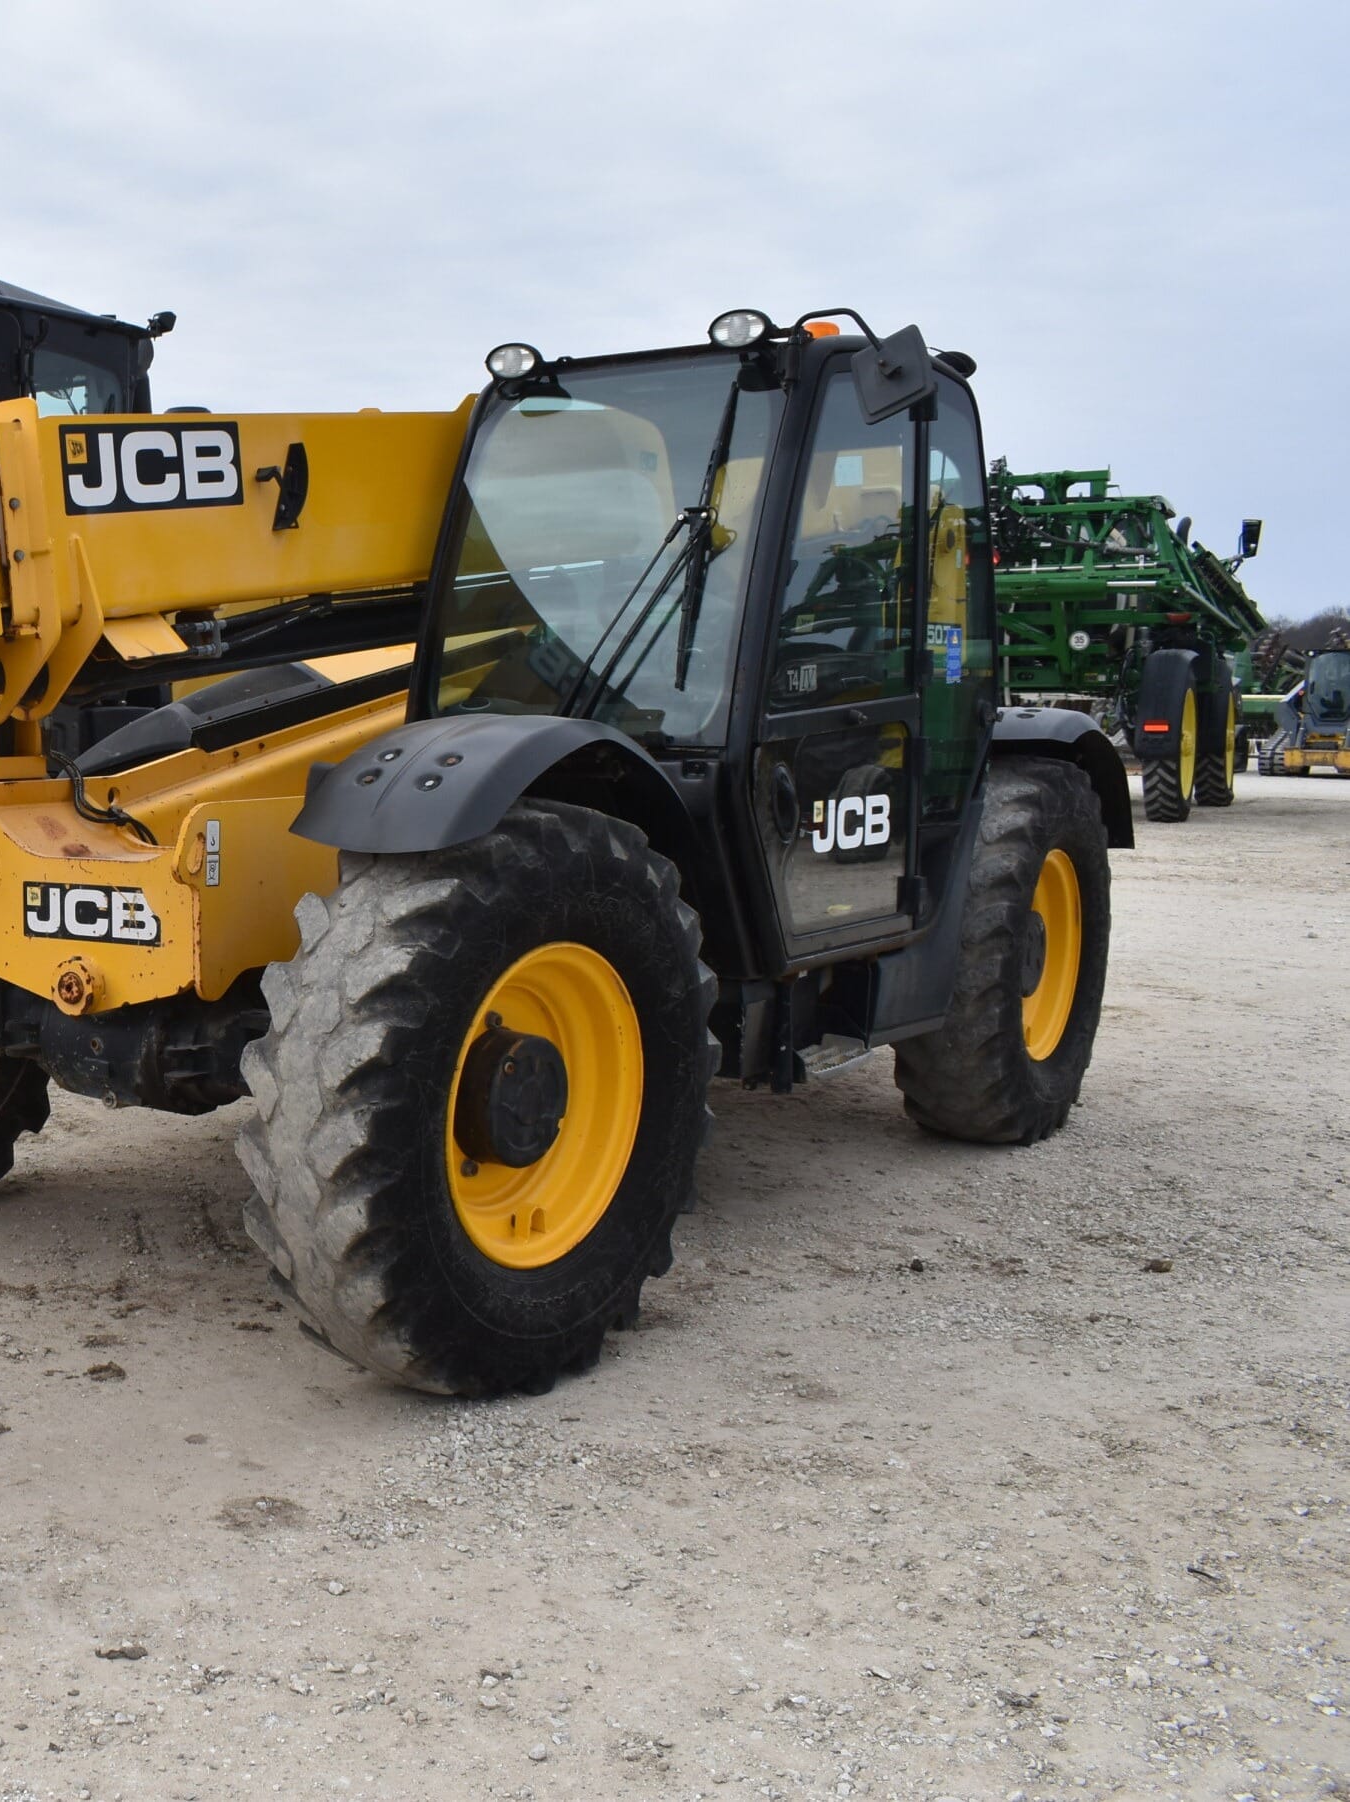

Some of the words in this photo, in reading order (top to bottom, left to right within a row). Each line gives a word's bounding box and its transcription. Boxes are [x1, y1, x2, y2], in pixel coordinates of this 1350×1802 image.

[68, 430, 239, 508] JCB
[1074, 635, 1085, 644] 35
[812, 794, 890, 853] JCB
[26, 887, 157, 941] JCB
